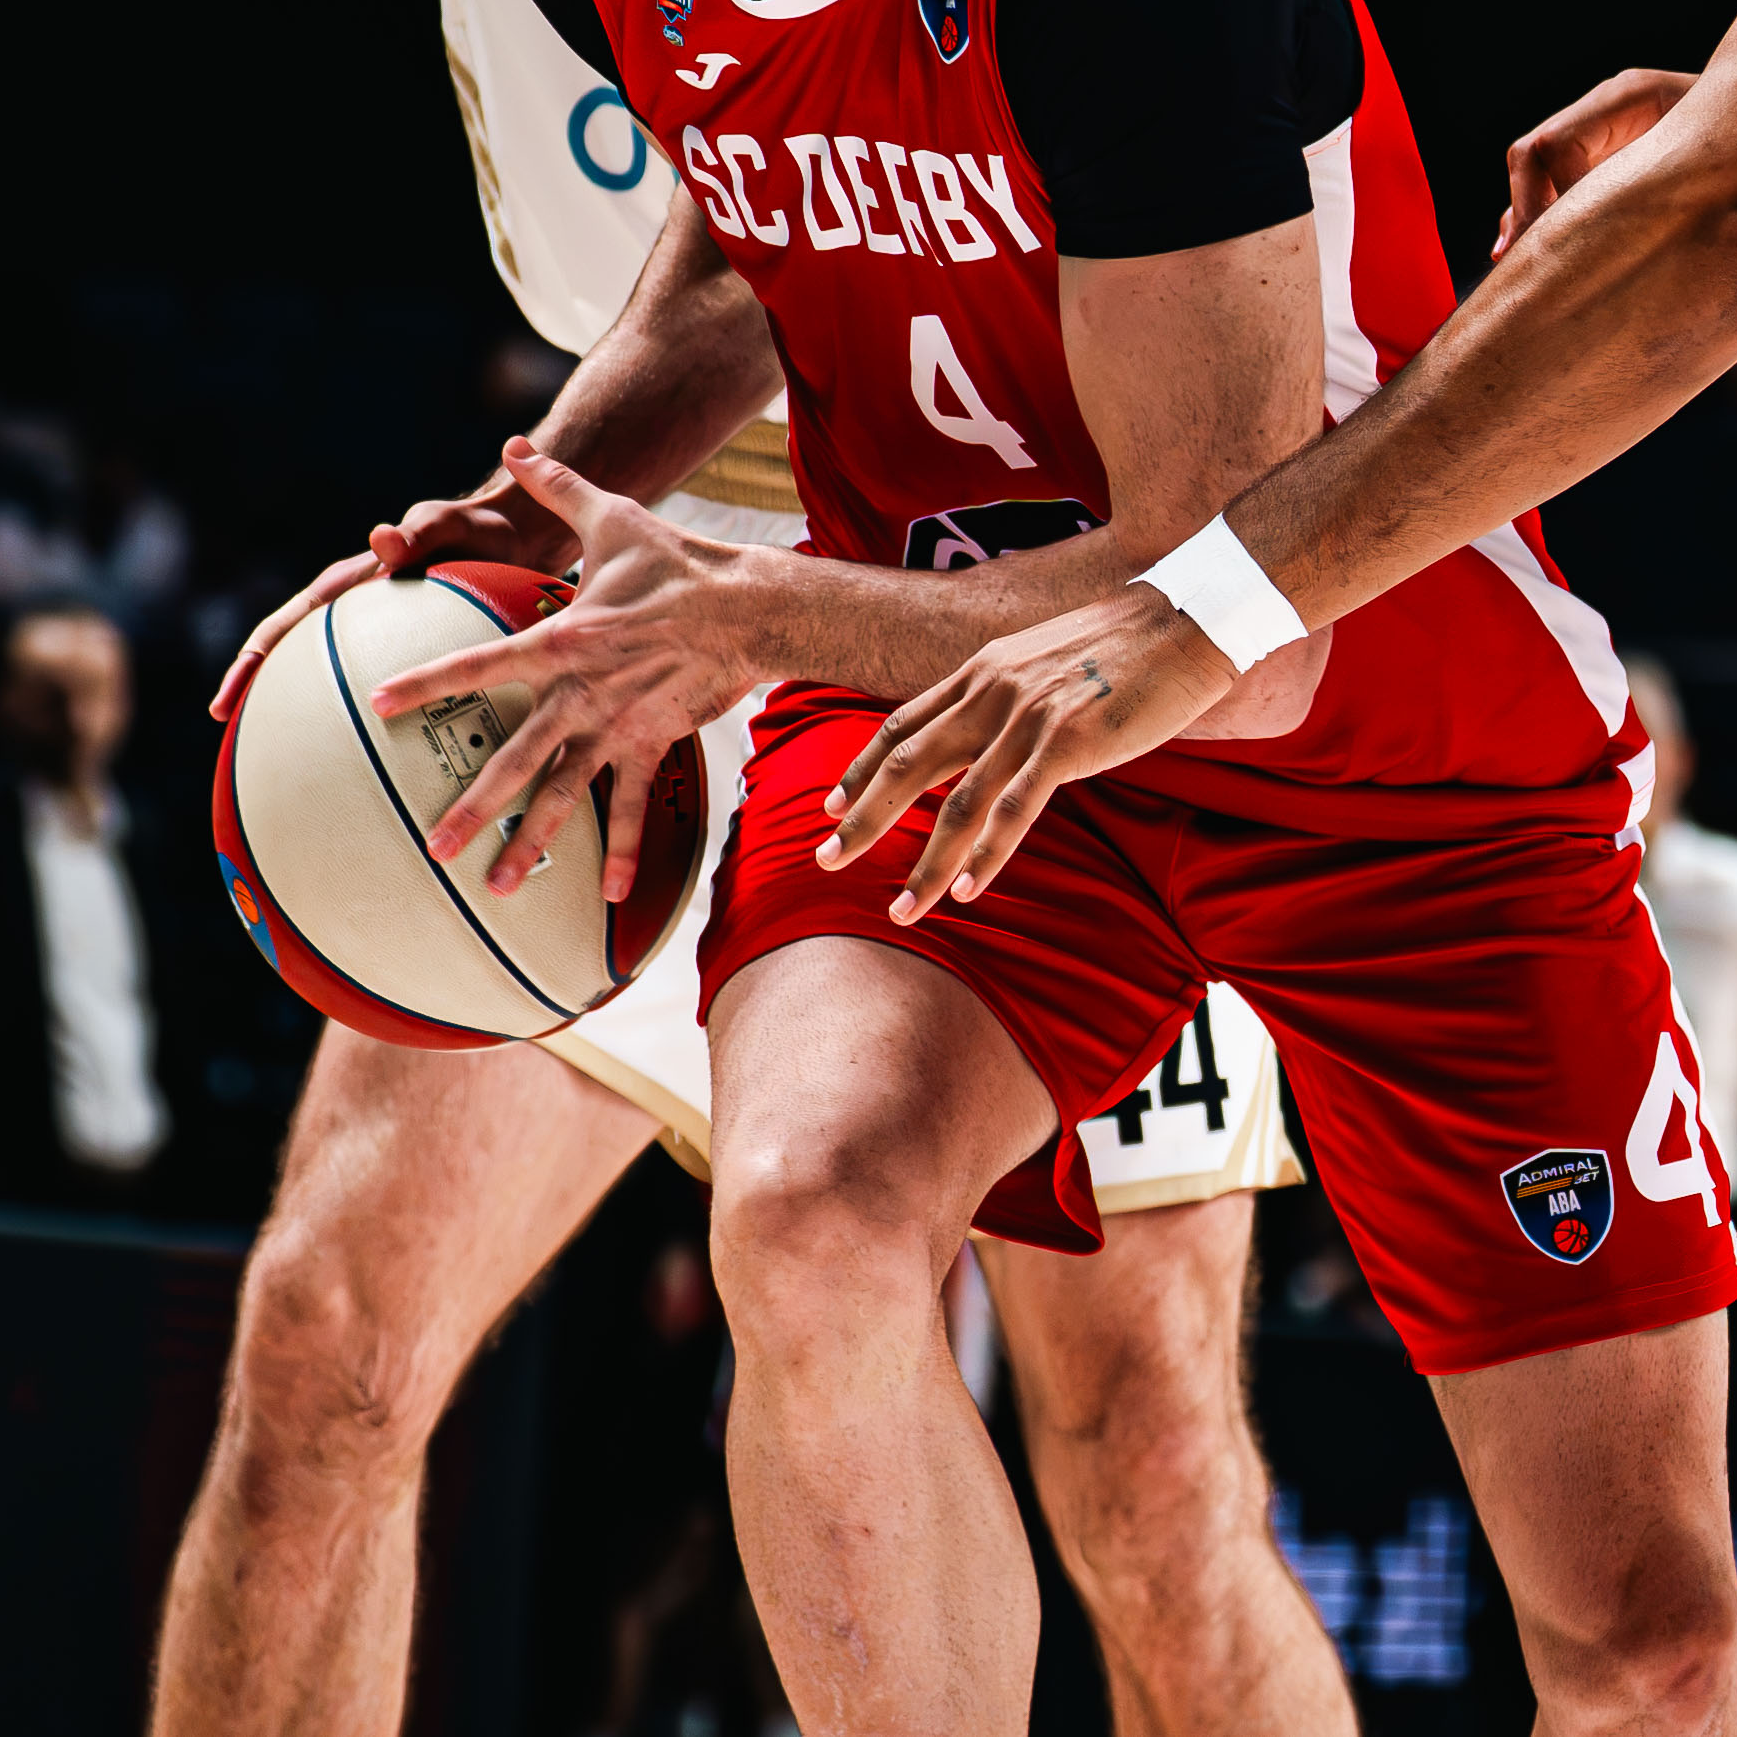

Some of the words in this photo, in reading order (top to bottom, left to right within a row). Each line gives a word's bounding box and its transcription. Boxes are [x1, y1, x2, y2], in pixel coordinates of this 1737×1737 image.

[683, 124, 788, 246] SC
[784, 133, 1042, 266] DERBY
[910, 315, 1037, 469] 4
[1518, 1157, 1600, 1187] ADMIRAL
[1625, 1031, 1723, 1228] 4
[1548, 1189, 1582, 1217] ABA
